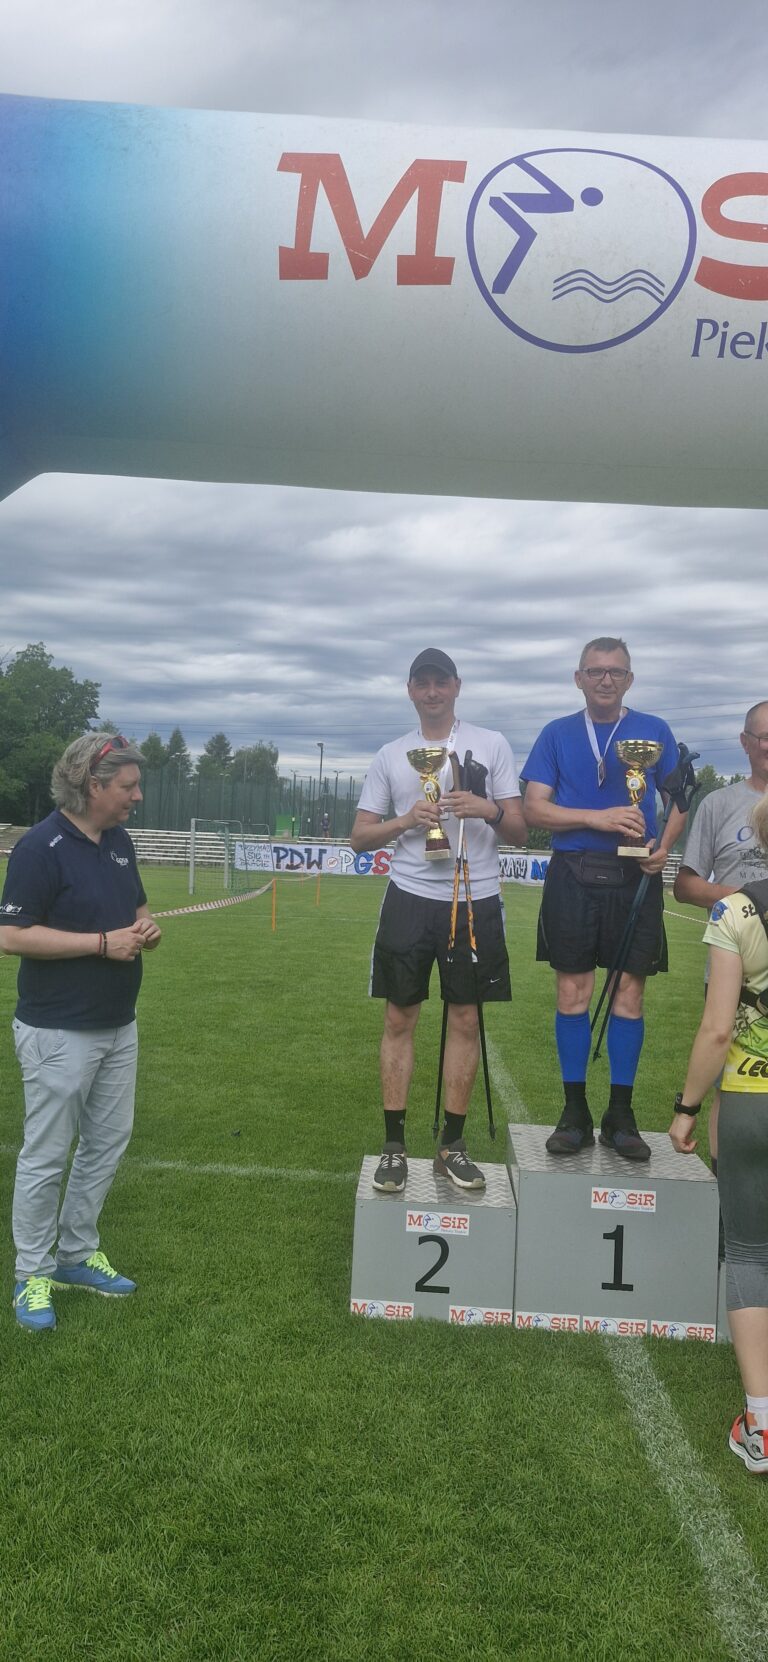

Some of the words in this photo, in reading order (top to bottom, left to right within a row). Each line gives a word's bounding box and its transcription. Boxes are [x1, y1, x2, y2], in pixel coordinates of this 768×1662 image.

[273, 846, 327, 870] PDW
[339, 850, 393, 875] PGS
[415, 1234, 450, 1294] 2
[602, 1224, 634, 1292] 1
